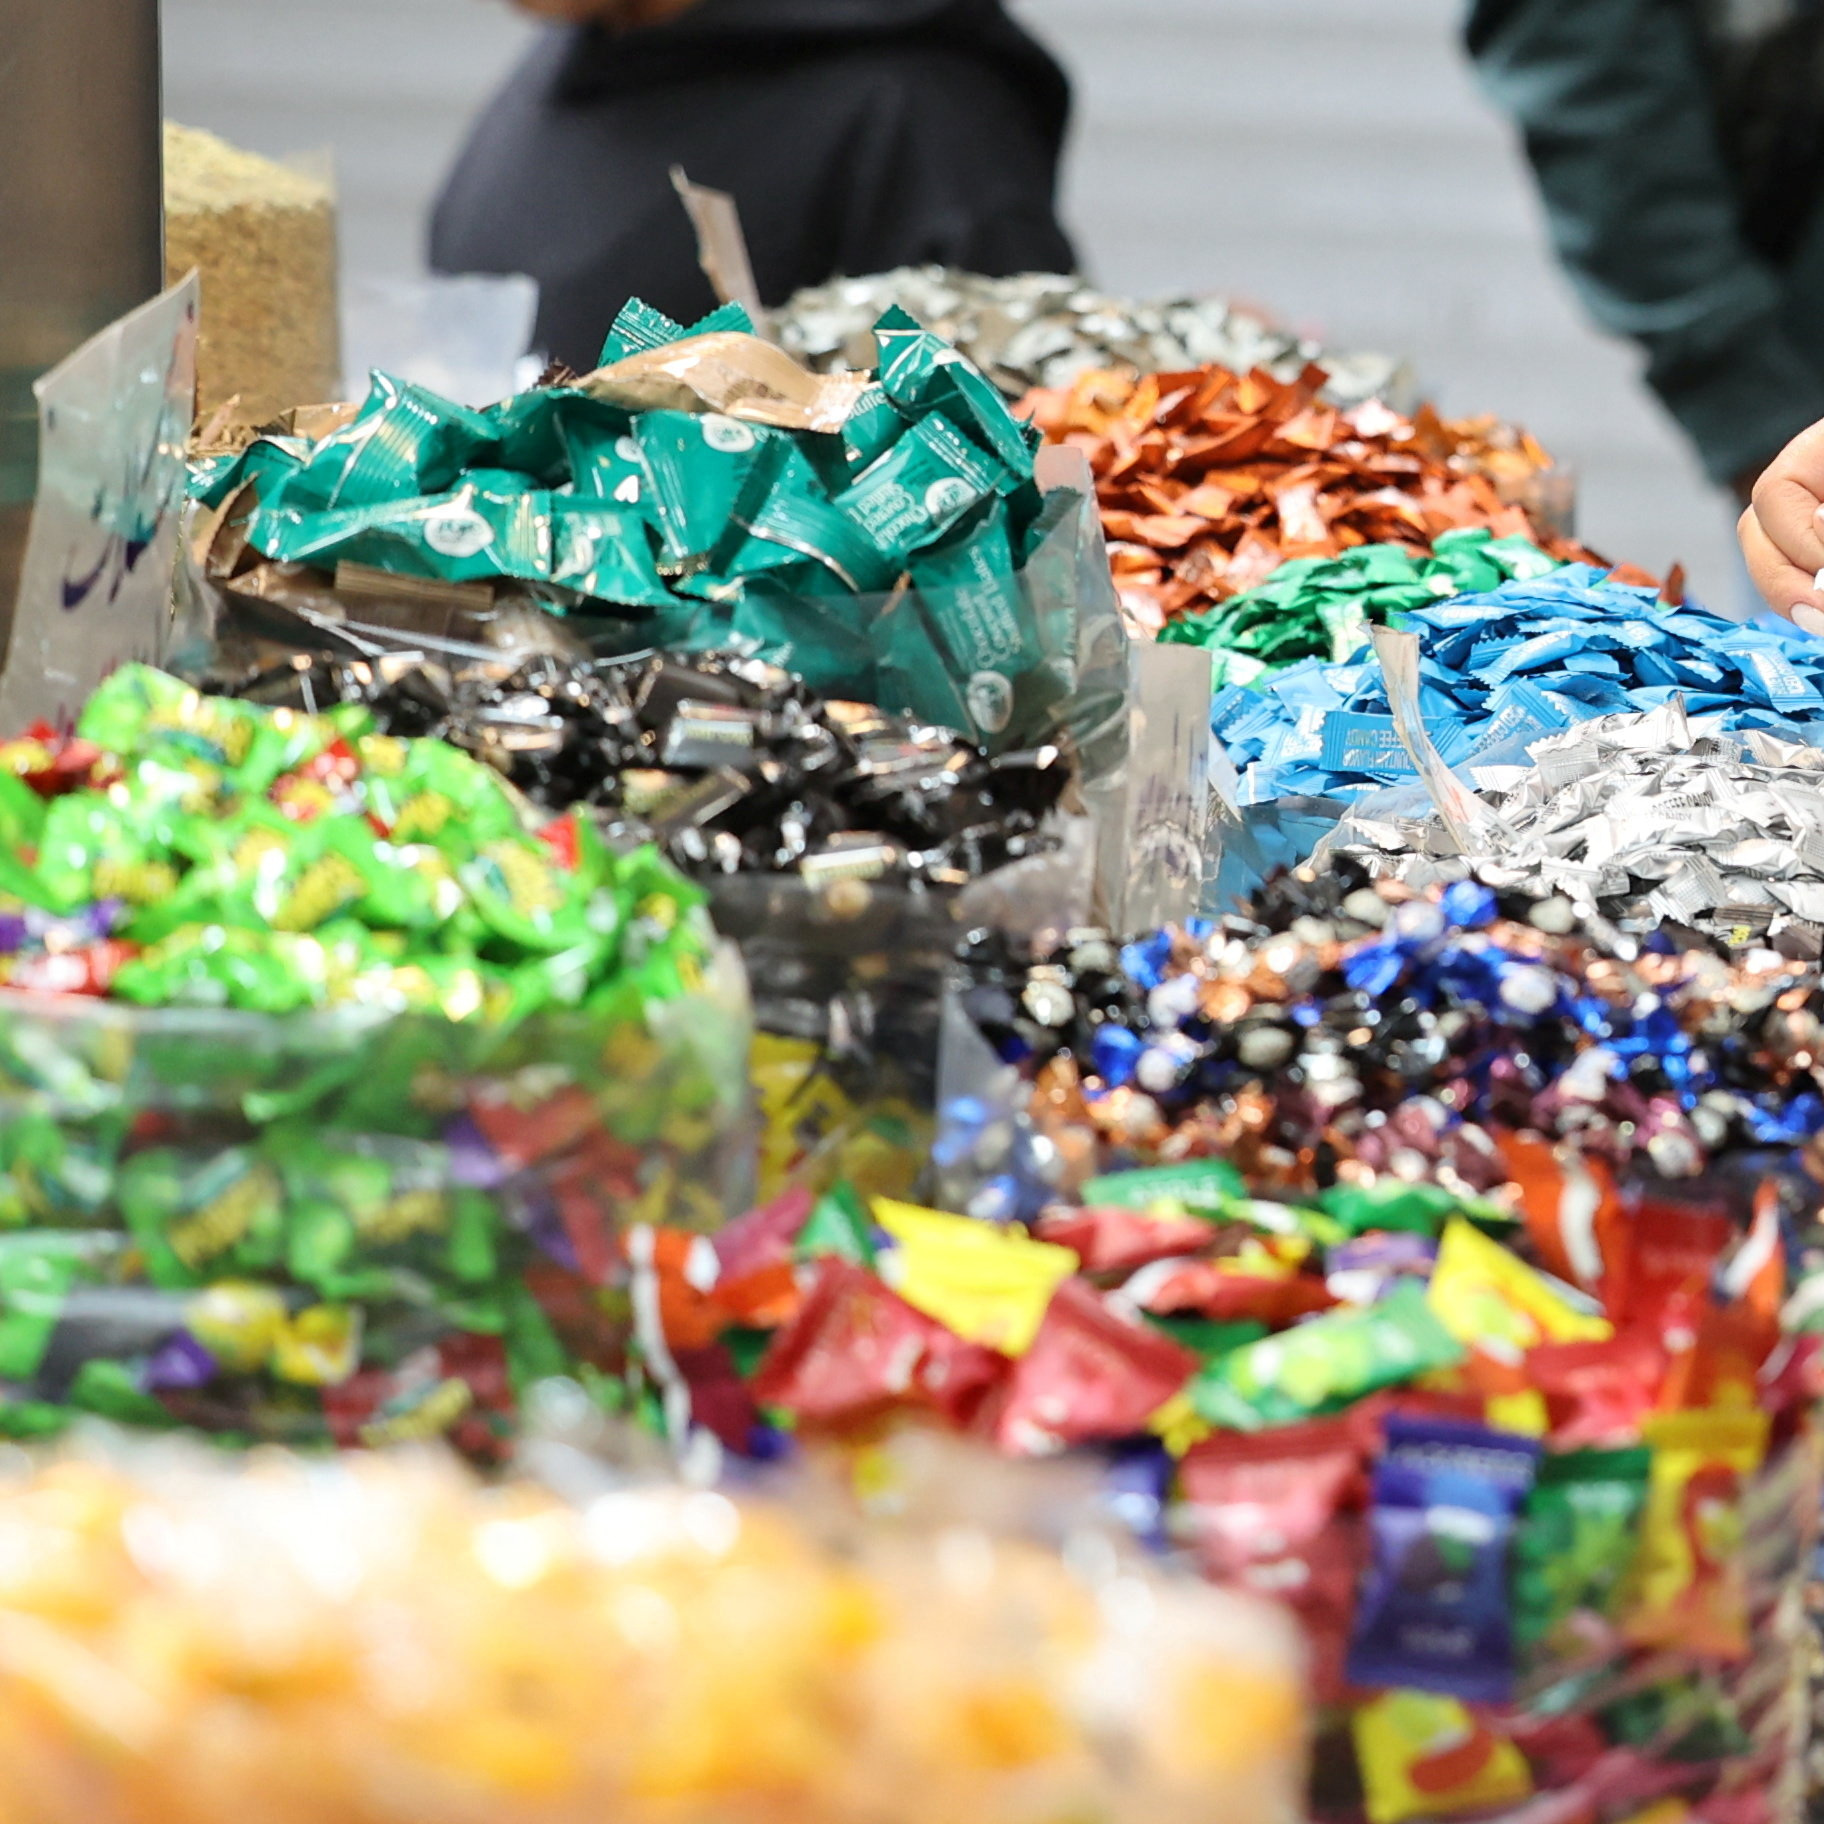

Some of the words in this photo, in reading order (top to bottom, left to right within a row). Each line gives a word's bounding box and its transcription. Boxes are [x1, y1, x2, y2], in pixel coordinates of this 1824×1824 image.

[857, 480, 904, 517] Stuffed
[863, 492, 916, 533] Covered
[969, 544, 999, 595] Dates
[955, 587, 996, 669] Chocolate
